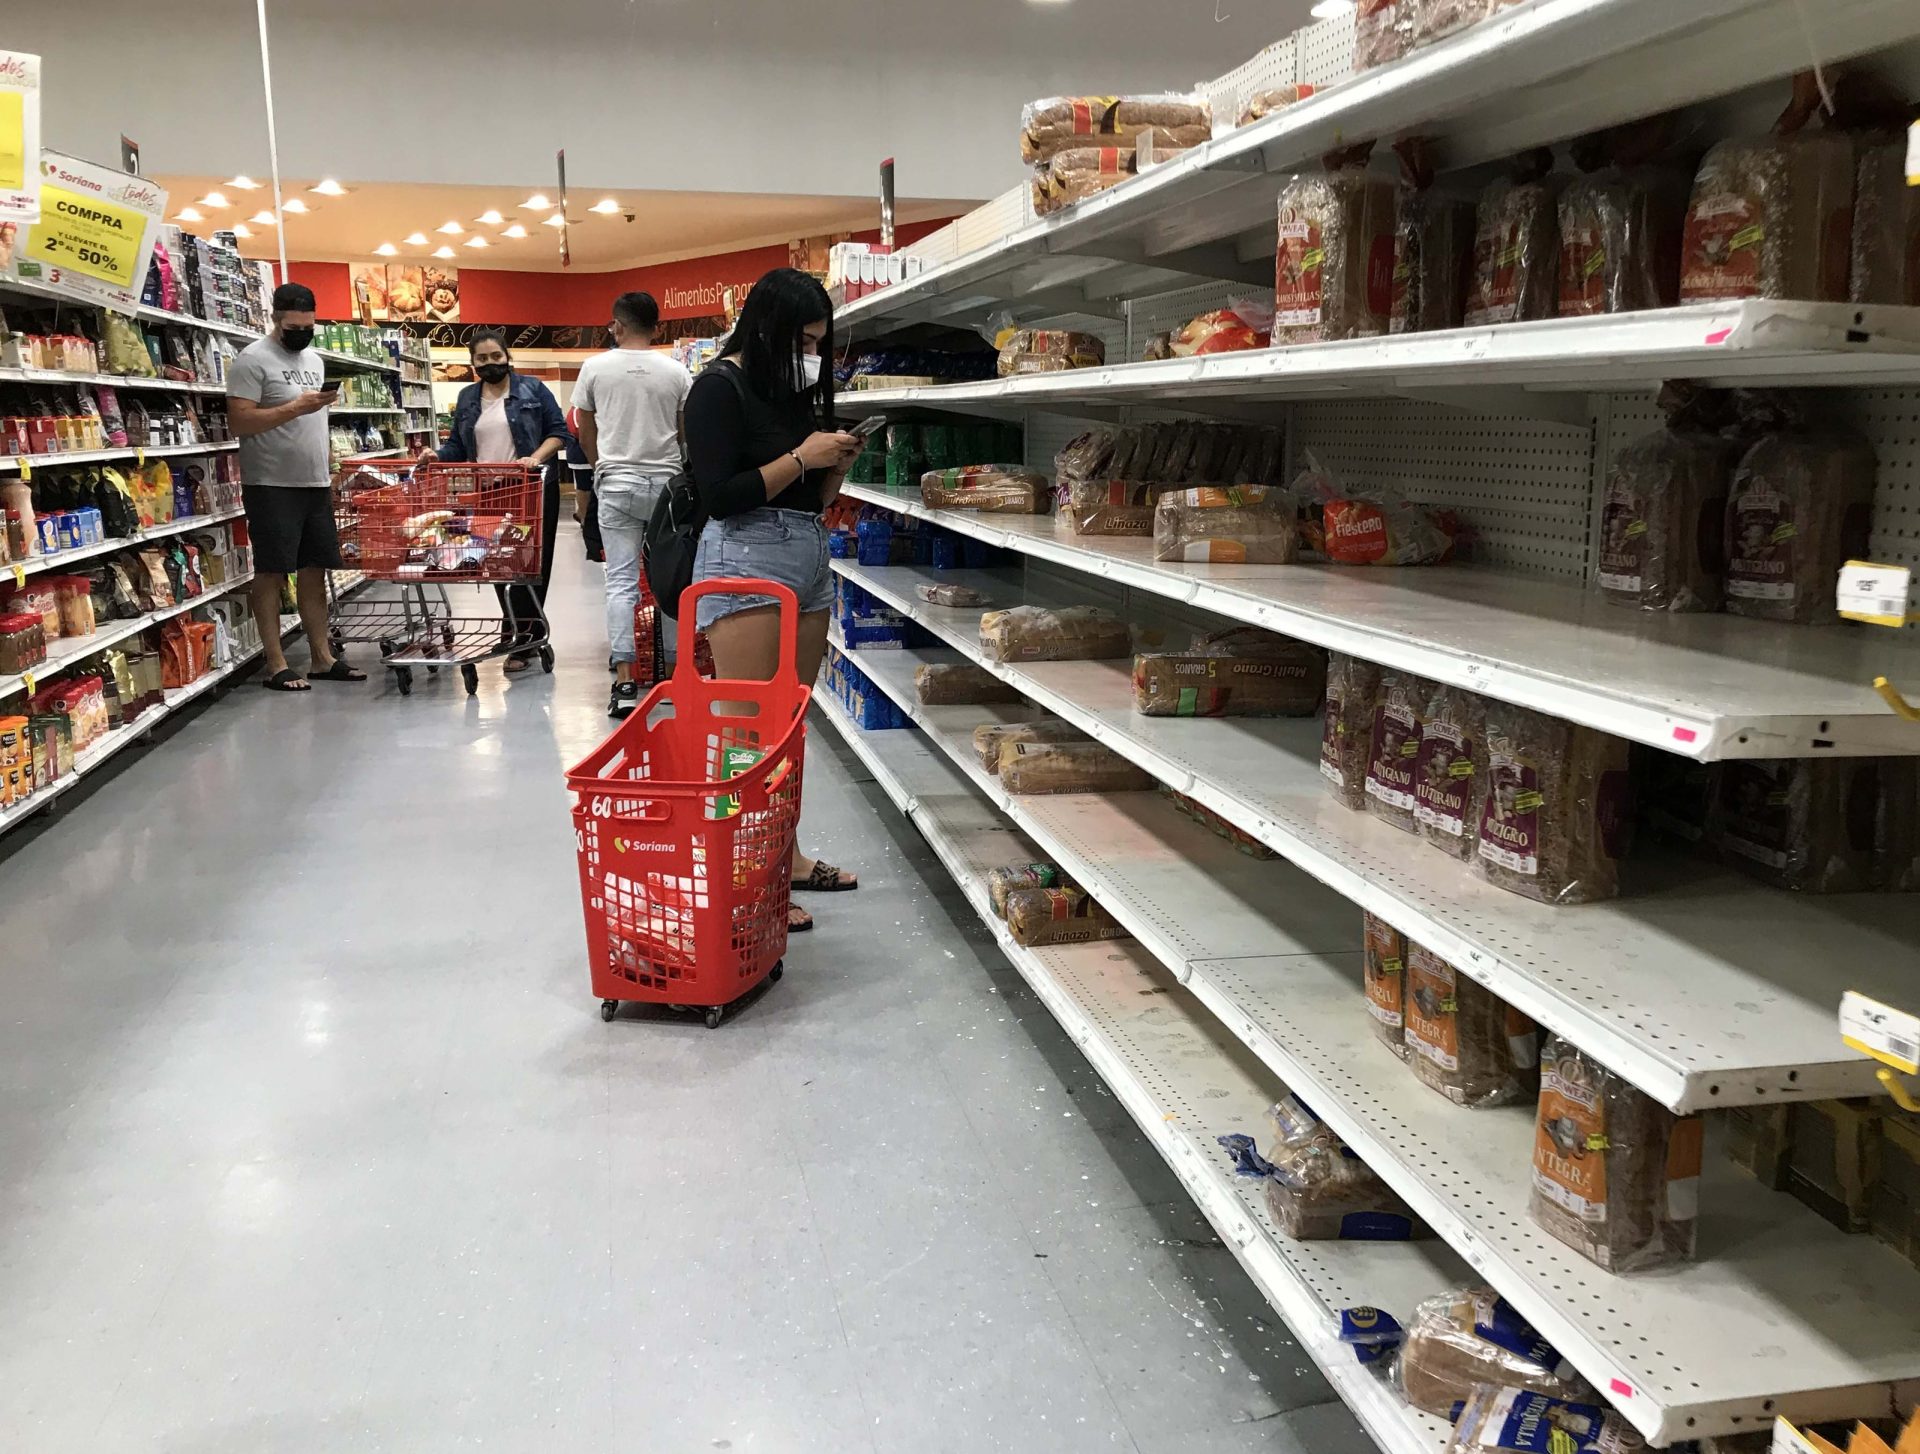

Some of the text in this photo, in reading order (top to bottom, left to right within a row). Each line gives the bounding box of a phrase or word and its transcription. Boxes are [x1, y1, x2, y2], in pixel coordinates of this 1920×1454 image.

[58, 170, 102, 192] Soriana
[122, 183, 158, 206] todos
[56, 200, 123, 230] COMPRA
[99, 244, 109, 252] EL
[78, 247, 118, 272] 50%
[663, 283, 716, 310] Alimentos
[282, 370, 314, 386] POLO
[1004, 496, 1025, 505] GRANOS
[1103, 516, 1150, 531] Linaza
[1175, 663, 1206, 675] GRANOS
[1208, 661, 1216, 678] 5
[1232, 663, 1272, 677] Grano
[591, 795, 612, 819] 60
[632, 840, 676, 852] Soriana
[1050, 929, 1091, 941] Linaza
